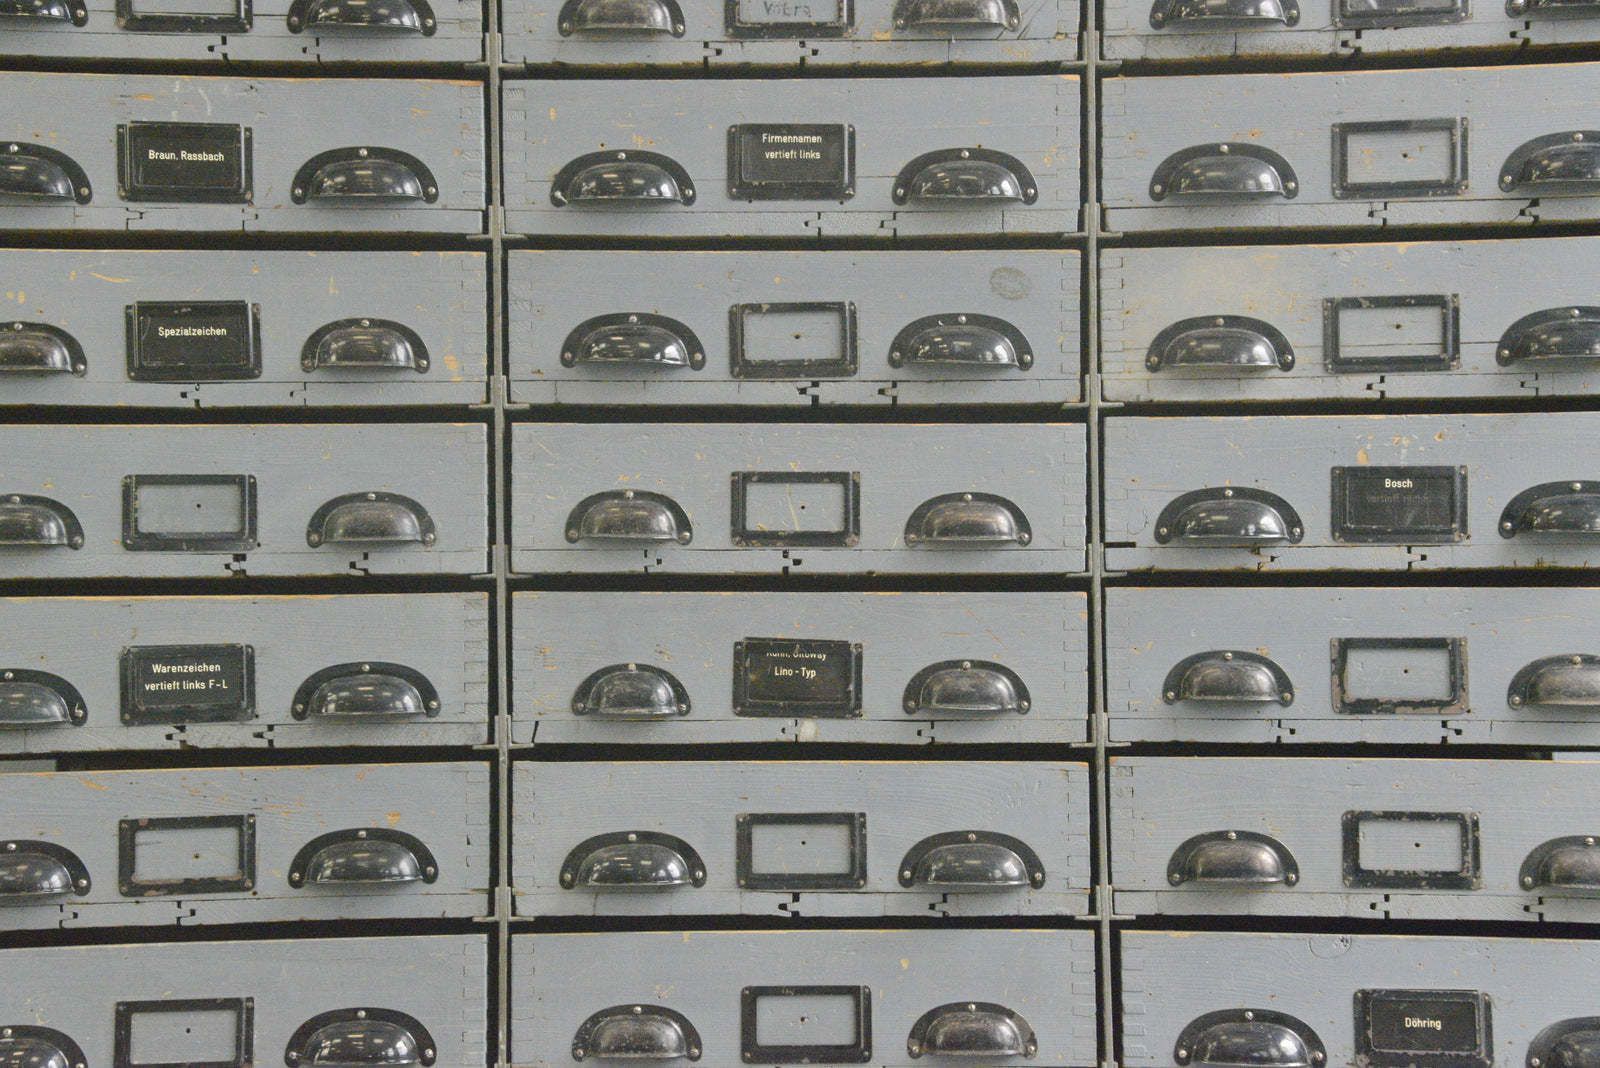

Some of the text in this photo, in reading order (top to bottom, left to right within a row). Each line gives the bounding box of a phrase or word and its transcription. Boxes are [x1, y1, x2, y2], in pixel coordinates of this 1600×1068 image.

[761, 132, 823, 144] Firmennamen
[180, 150, 225, 162] Rassbach
[764, 148, 821, 160] vertieft links
[157, 325, 228, 339] Spezialzeichen
[1384, 477, 1413, 489] Bosch
[152, 662, 221, 674] Warenzeichen
[144, 681, 181, 692] vertieft
[182, 680, 207, 691] links
[1404, 1016, 1442, 1031] Döhring
